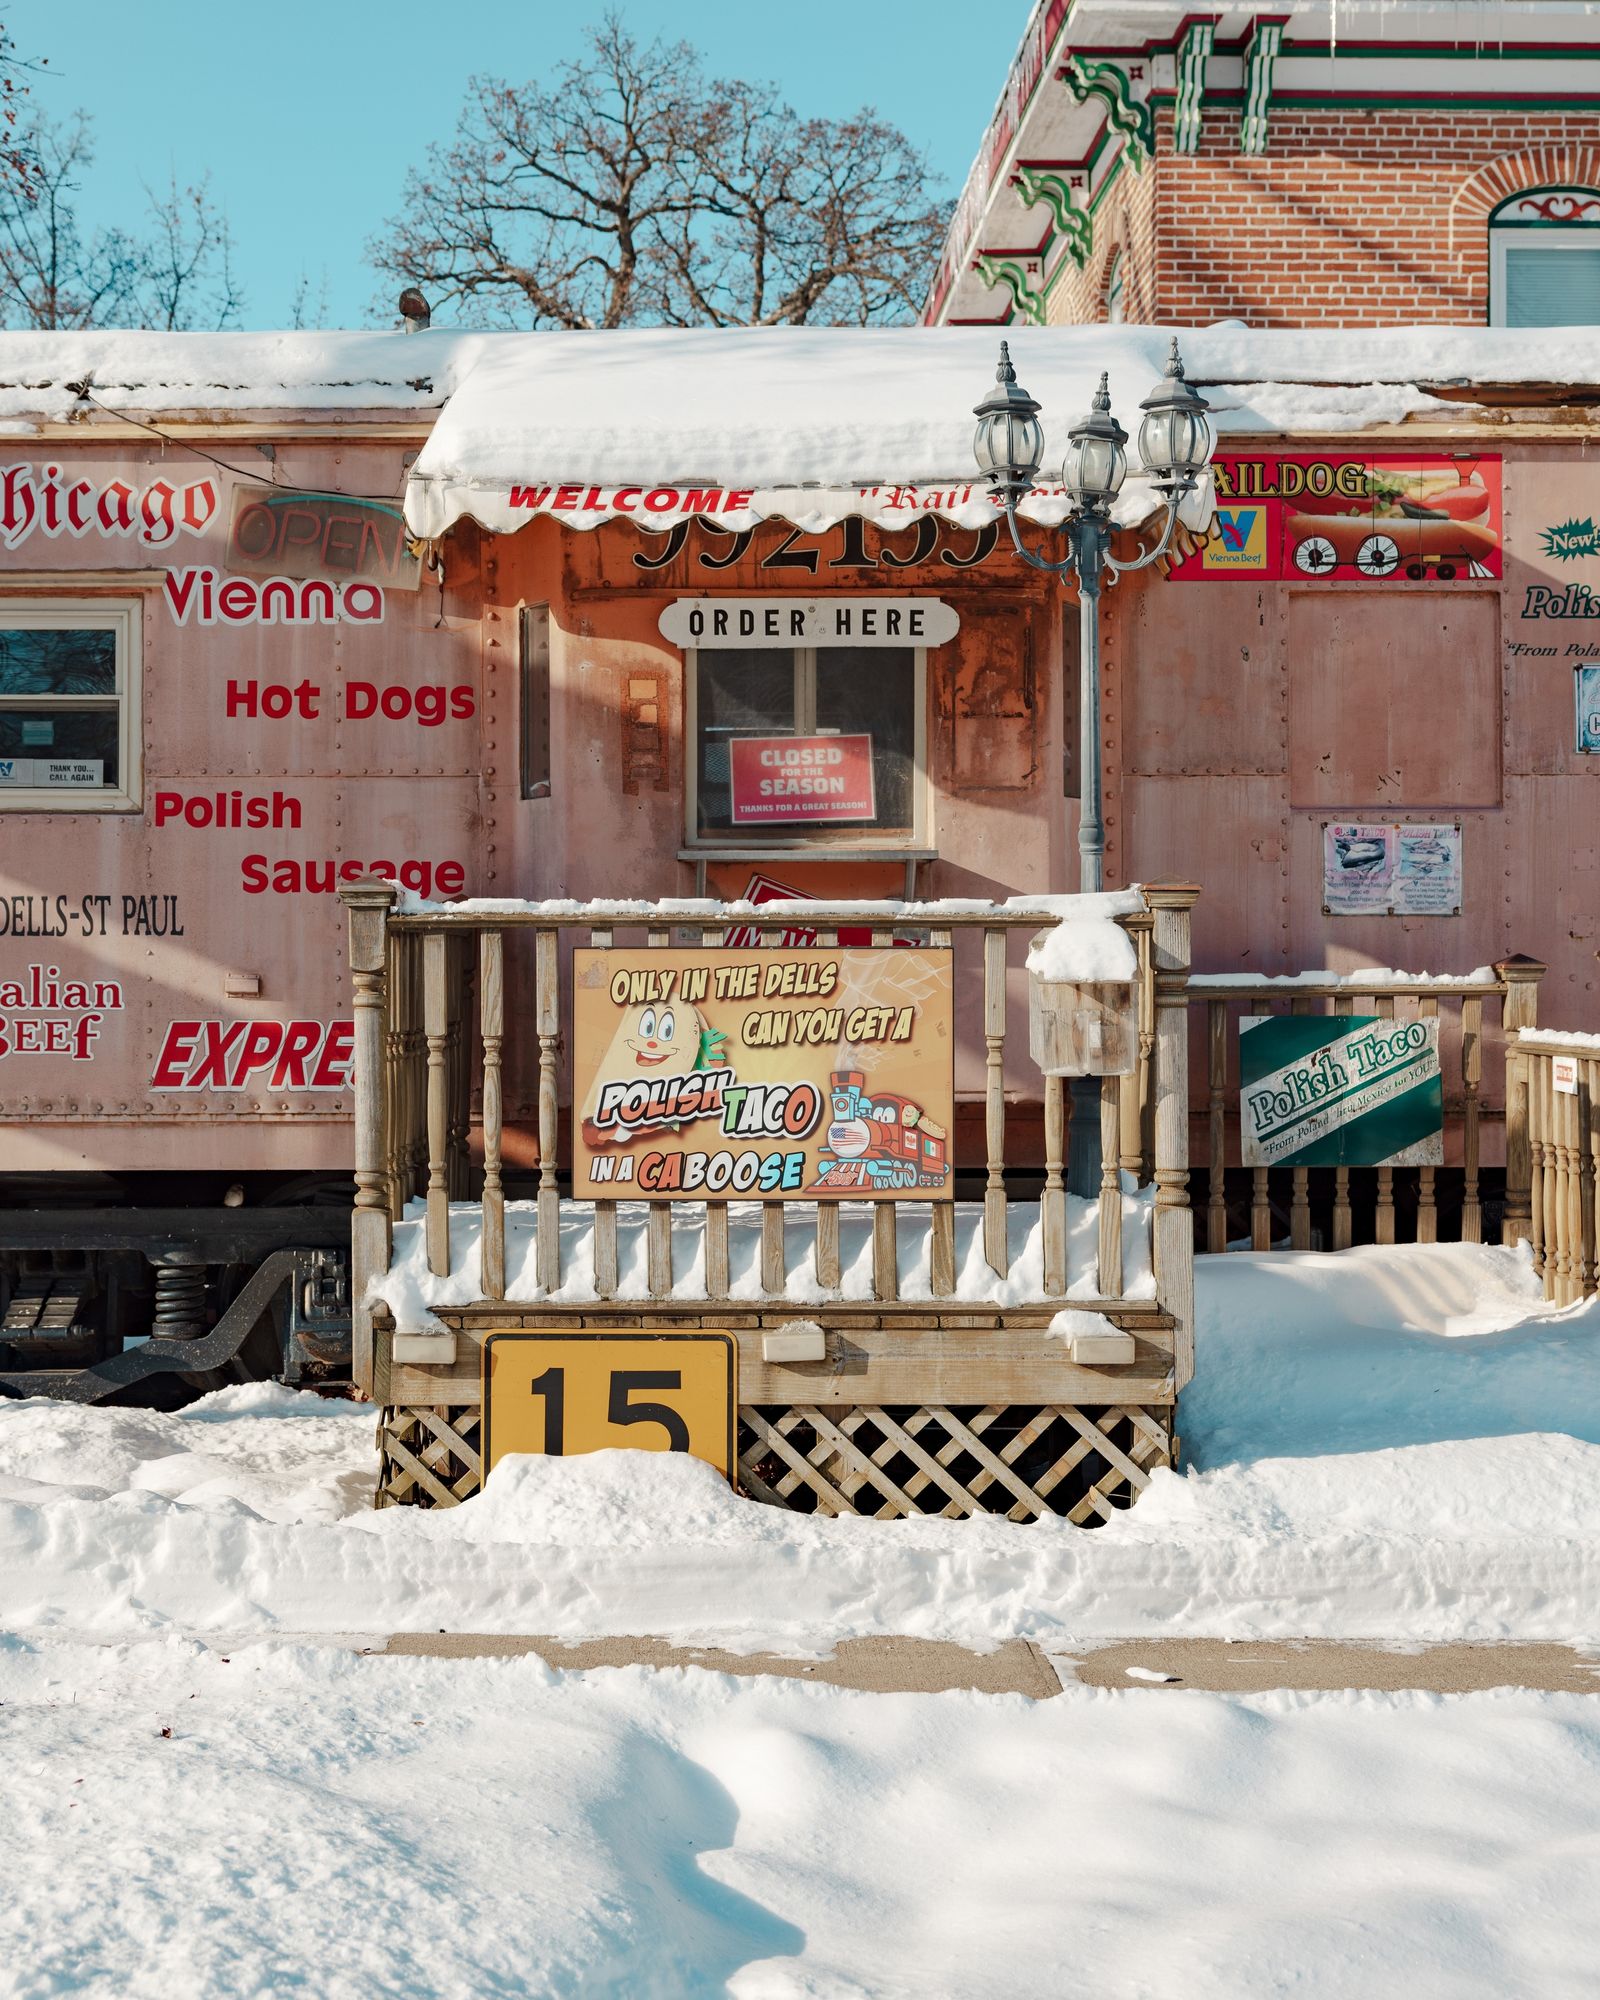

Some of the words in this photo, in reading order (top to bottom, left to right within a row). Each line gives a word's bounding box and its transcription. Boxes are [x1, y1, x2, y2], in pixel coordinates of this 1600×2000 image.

[509, 485, 754, 513] WELCOME
[233, 502, 406, 577] OPEN
[1552, 527, 1599, 552] New!
[1241, 553, 1262, 565] Beef
[166, 570, 382, 620] Vienna
[689, 609, 805, 636] ORDER
[836, 608, 924, 636] HERE
[1563, 642, 1600, 657] Pola
[226, 680, 320, 720] Hot
[346, 681, 475, 726] Dogs
[49, 764, 72, 773] THANK
[760, 748, 842, 767] CLOSED
[781, 768, 800, 777] FOR
[803, 767, 823, 776] THE
[49, 774, 68, 782] CALL
[70, 774, 95, 782] AGAIN
[759, 776, 845, 796] SEASON
[155, 791, 302, 828] Polish
[740, 804, 773, 813] THANKS
[776, 803, 793, 812] FOR
[795, 803, 801, 811] A
[802, 802, 829, 811] GREAT
[831, 801, 867, 810] SEASON!
[122, 895, 184, 936] PAUL
[610, 969, 677, 1005] ONLY
[680, 968, 710, 1002] IN
[715, 964, 761, 1000] THE
[763, 961, 839, 998] DELLS
[742, 1010, 792, 1046] CAN
[794, 1006, 845, 1044] YOU
[845, 1006, 895, 1042] GET
[891, 1006, 915, 1041] A
[151, 1021, 355, 1088] EXPRE
[1248, 1054, 1349, 1131] Polish
[1346, 1022, 1427, 1077] Taco
[597, 1069, 733, 1124] POLISH
[721, 1085, 816, 1134] TACO
[1298, 1114, 1330, 1138] Poland
[1357, 1084, 1392, 1107] Mexico
[589, 1155, 617, 1183] IN
[615, 1154, 635, 1182] A
[637, 1150, 806, 1193] CABOOSE
[531, 1367, 690, 1458] 15
